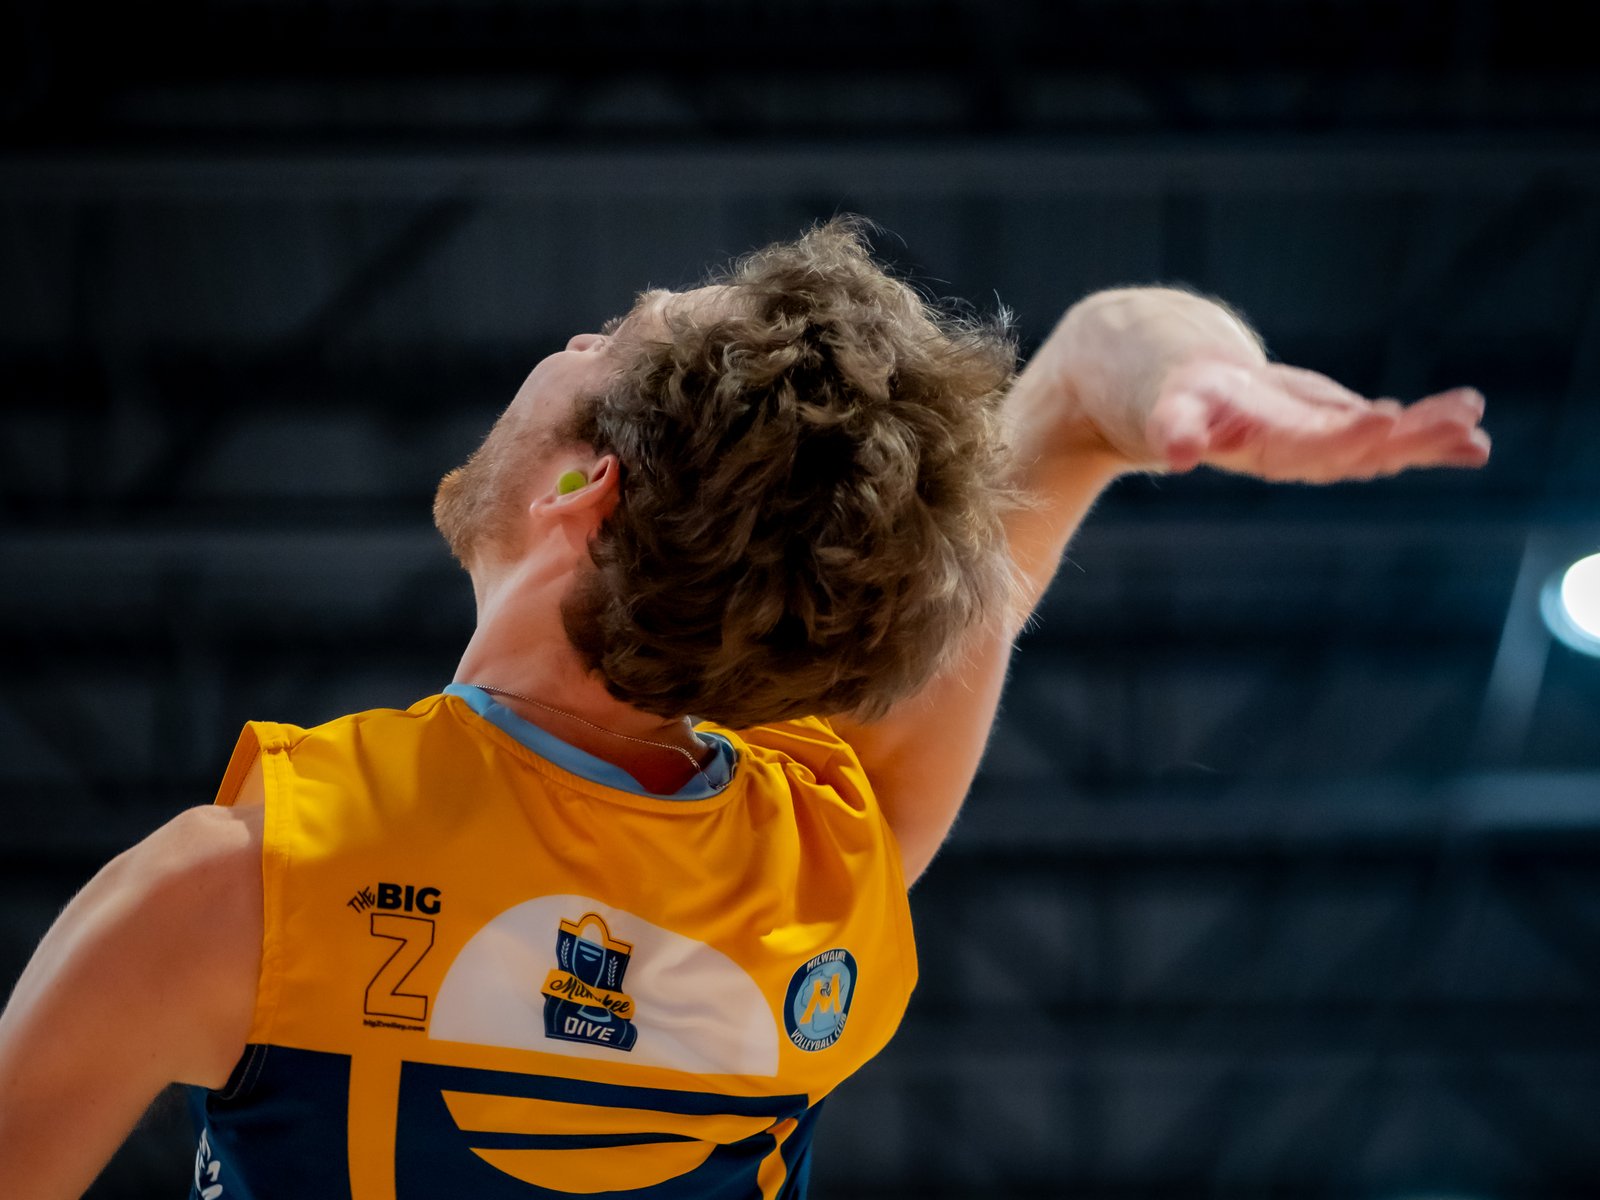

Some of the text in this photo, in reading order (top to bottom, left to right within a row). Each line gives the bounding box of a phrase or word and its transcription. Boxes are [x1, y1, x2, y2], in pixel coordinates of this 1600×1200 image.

[347, 882, 442, 915] THE BIG
[563, 1016, 616, 1042] DIVE
[790, 1028, 834, 1051] VOLLEYBALL
